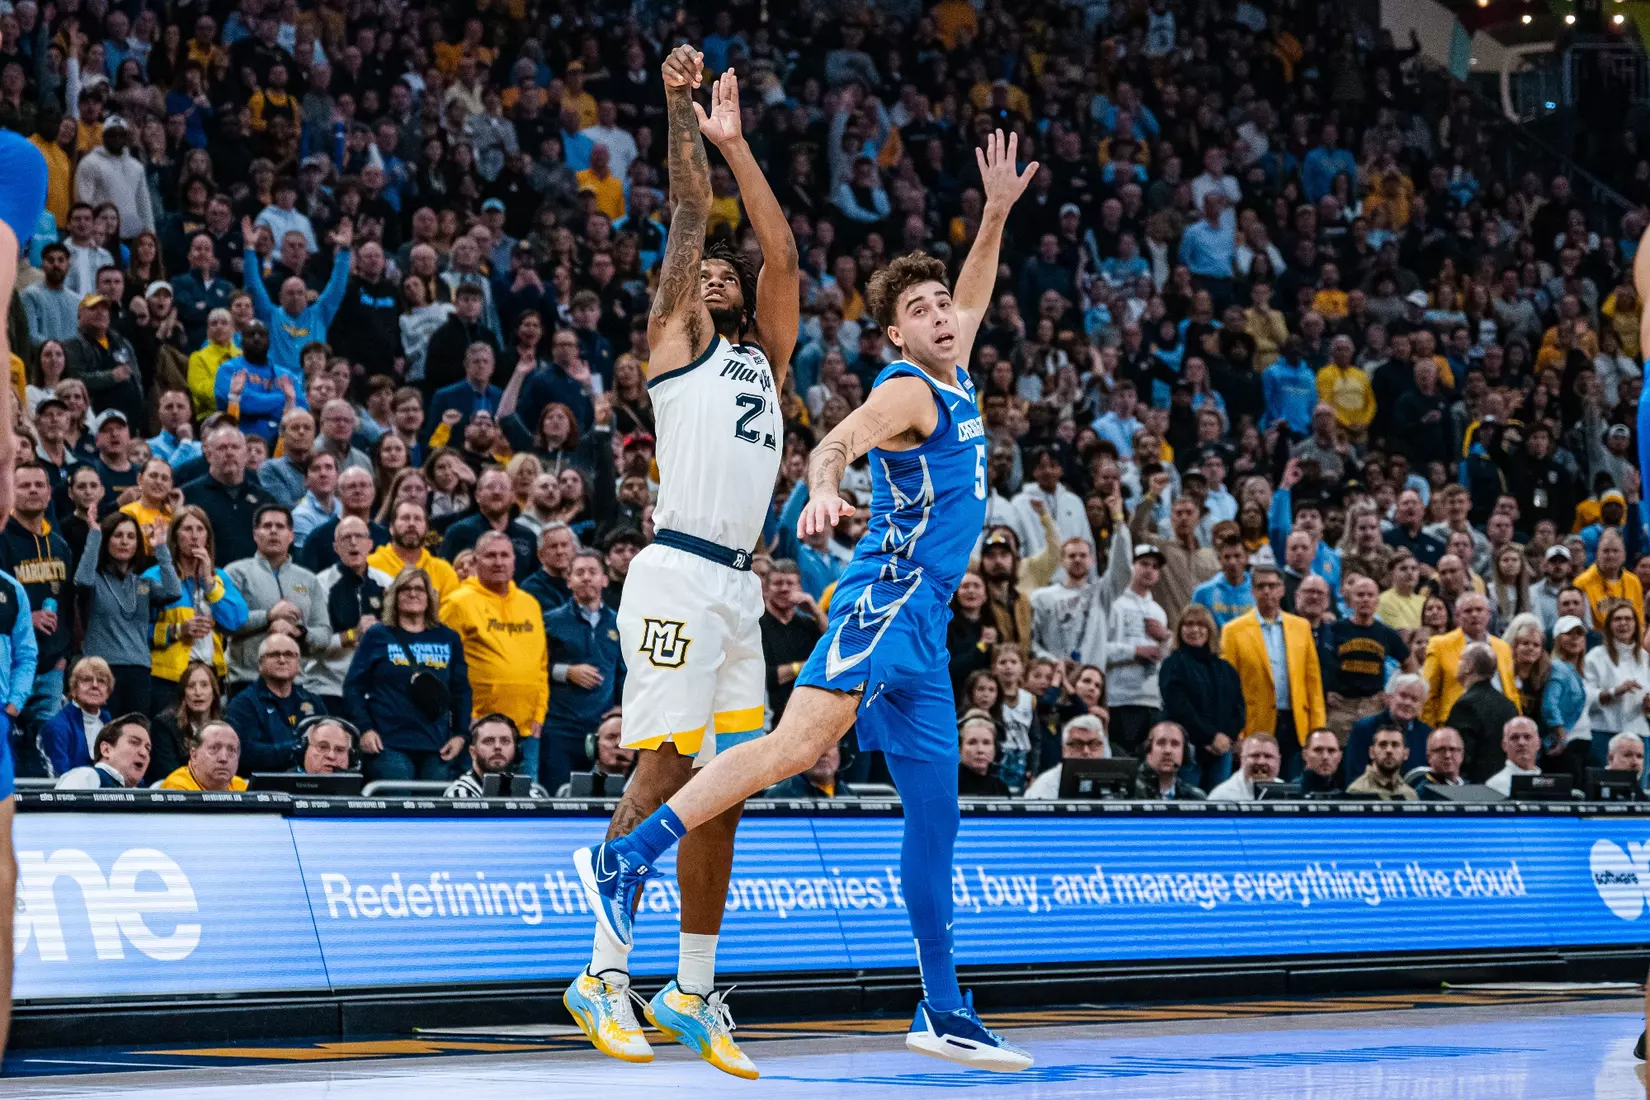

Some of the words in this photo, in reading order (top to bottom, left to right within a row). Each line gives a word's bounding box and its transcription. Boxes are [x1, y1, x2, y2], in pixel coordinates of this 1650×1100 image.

[974, 444, 987, 501] 5
[639, 617, 692, 668] MU
[320, 871, 544, 925] Redefining
[544, 870, 591, 915] th
[725, 866, 883, 918] ompanies
[976, 865, 1051, 913] buy,
[1052, 864, 1111, 905] and
[1112, 871, 1231, 911] manage
[1232, 861, 1381, 907] everything
[1374, 861, 1408, 898] in
[1405, 861, 1453, 899] the
[1453, 860, 1527, 897] cloud
